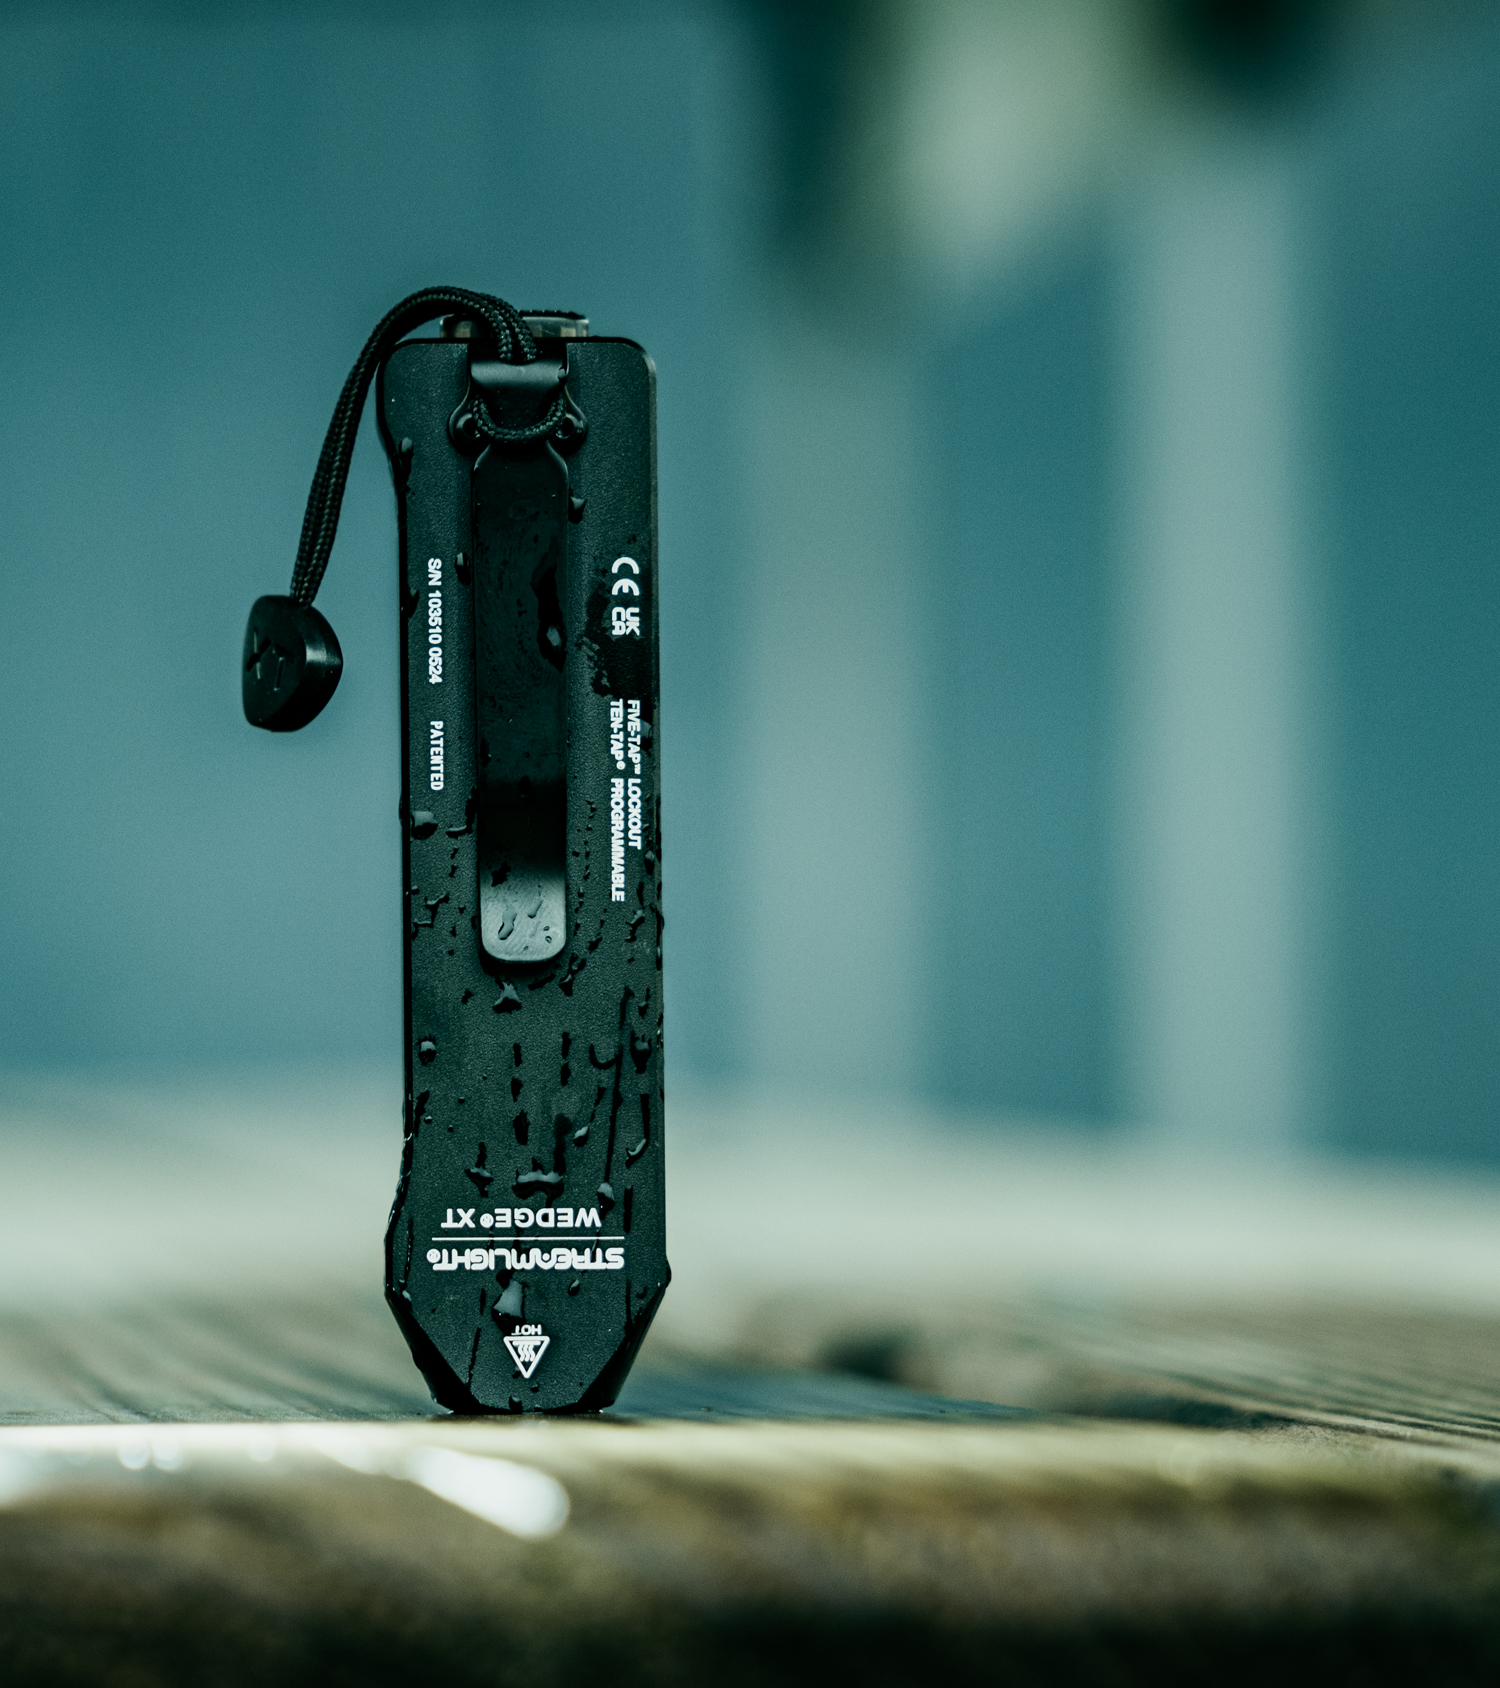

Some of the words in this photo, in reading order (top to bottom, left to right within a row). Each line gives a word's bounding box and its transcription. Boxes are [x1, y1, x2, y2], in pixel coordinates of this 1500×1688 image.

[428, 558, 441, 585] S/N
[612, 557, 639, 595] CE
[429, 590, 442, 644] 103510
[612, 607, 625, 635] CA
[625, 607, 639, 635] UK
[429, 647, 442, 684] 0524
[430, 721, 443, 790] PATENTED
[628, 778, 641, 849] LOCKOUT
[611, 778, 624, 901] PROGRAMMABLE
[441, 1209, 475, 1228] XT
[512, 1325, 541, 1335] HOT
